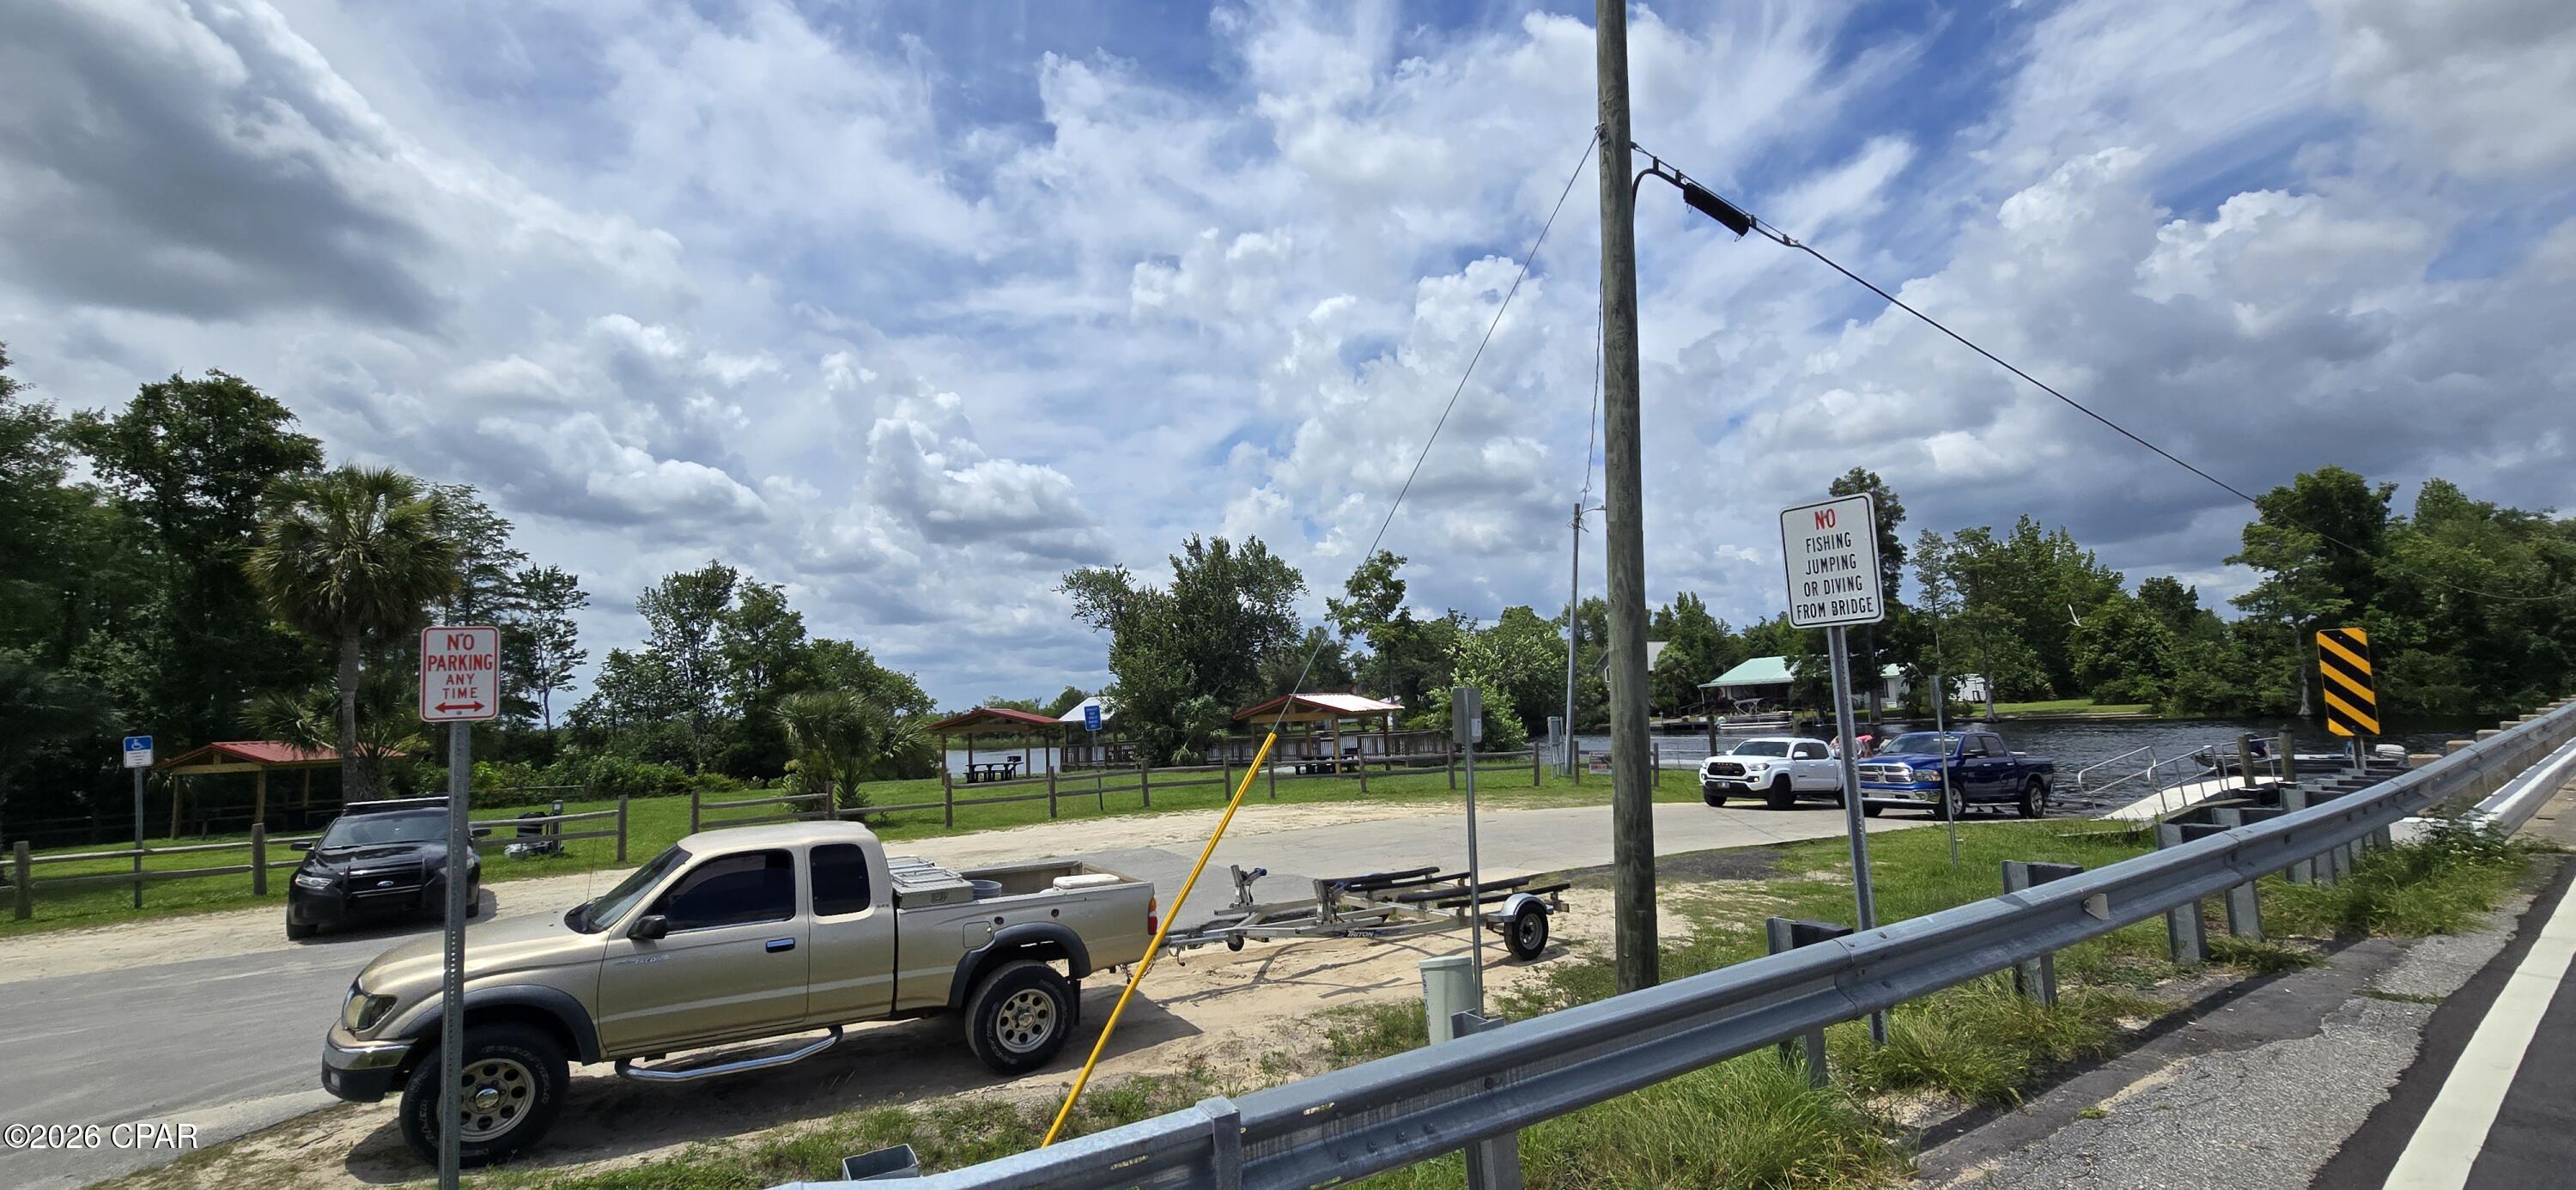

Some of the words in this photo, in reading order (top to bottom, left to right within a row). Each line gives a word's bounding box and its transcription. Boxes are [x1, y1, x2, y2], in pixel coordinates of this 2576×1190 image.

[1814, 508, 1836, 531] NO
[1806, 532, 1851, 554] FISHING
[1806, 554, 1856, 575] JUMPING
[1803, 581, 1819, 598] OR
[1824, 575, 1862, 595] DIVING
[1796, 602, 1826, 620] FROM
[1832, 597, 1874, 616] BRIDGE
[447, 634, 475, 651] NO
[428, 653, 493, 671] PARKING
[446, 673, 475, 685] ANY
[442, 687, 477, 699] TIME
